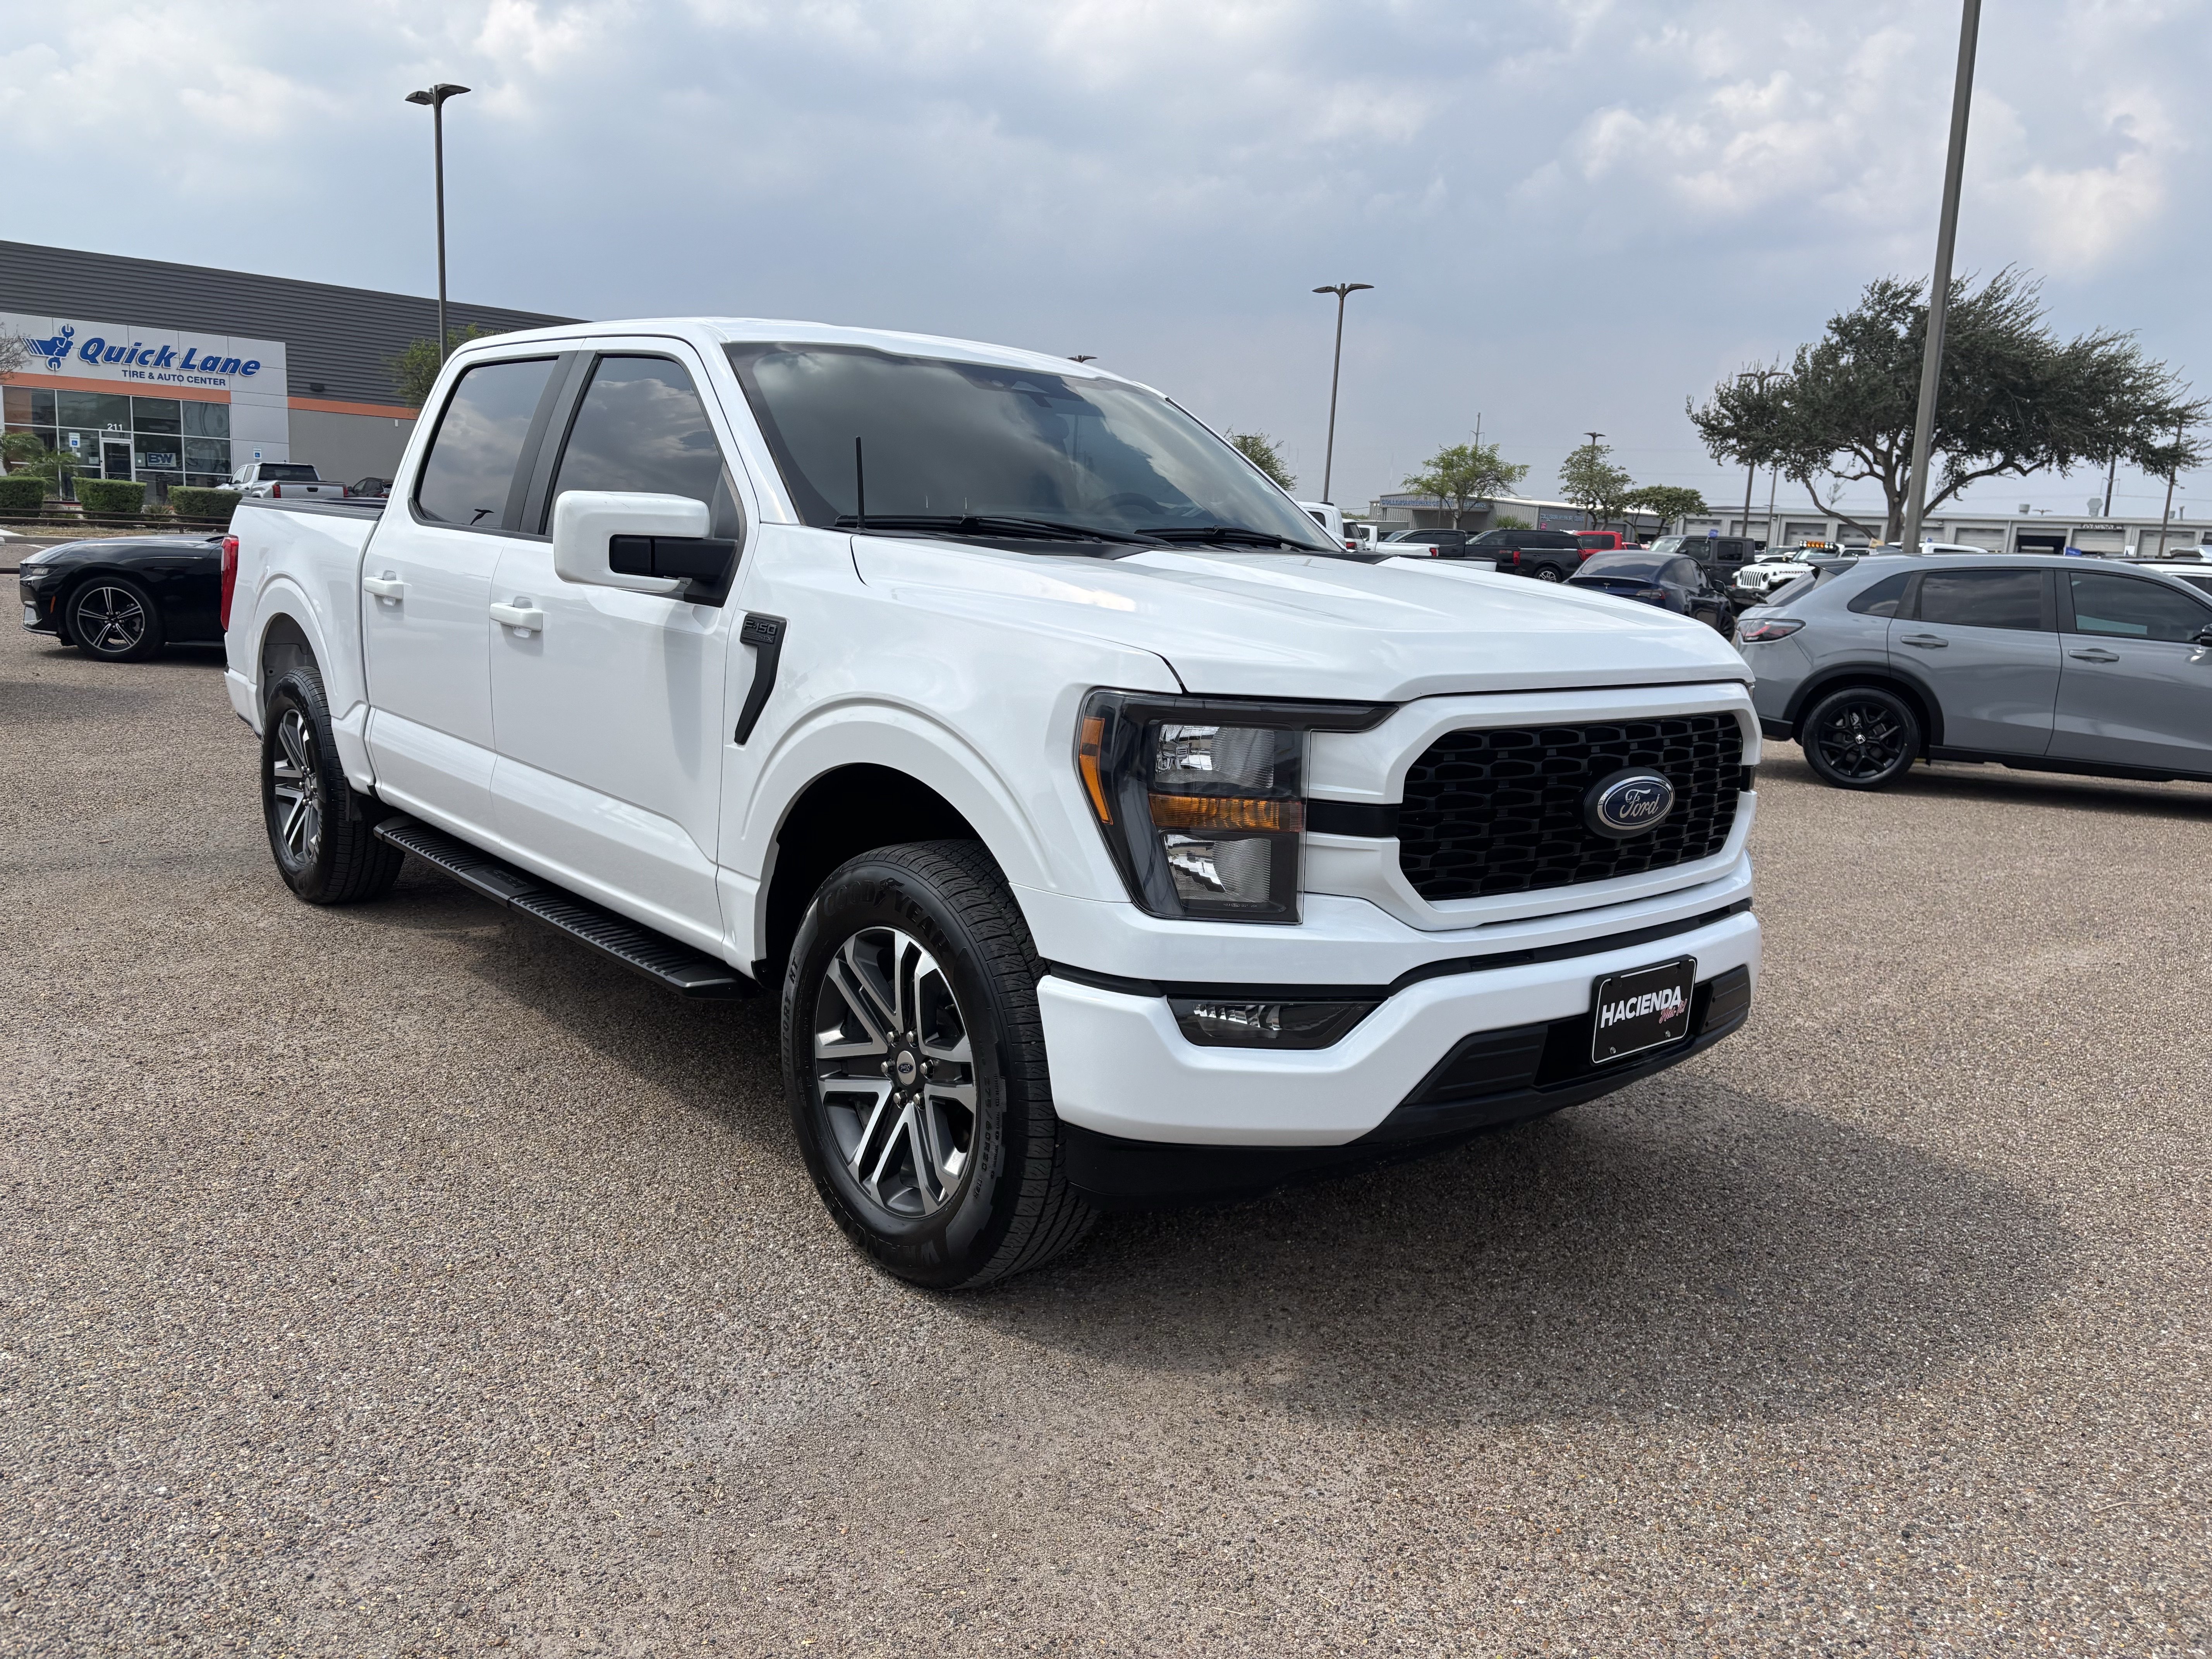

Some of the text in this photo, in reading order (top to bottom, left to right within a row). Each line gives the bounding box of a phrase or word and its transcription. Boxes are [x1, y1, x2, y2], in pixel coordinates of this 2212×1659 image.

[79, 338, 261, 376] Quick Lane
[122, 370, 145, 378] TIRE
[157, 373, 183, 382] AUTO
[187, 376, 226, 386] CENTER
[744, 621, 777, 635] F-150
[1620, 789, 1660, 818] Ford
[1601, 986, 1681, 1028] HACIENDA
